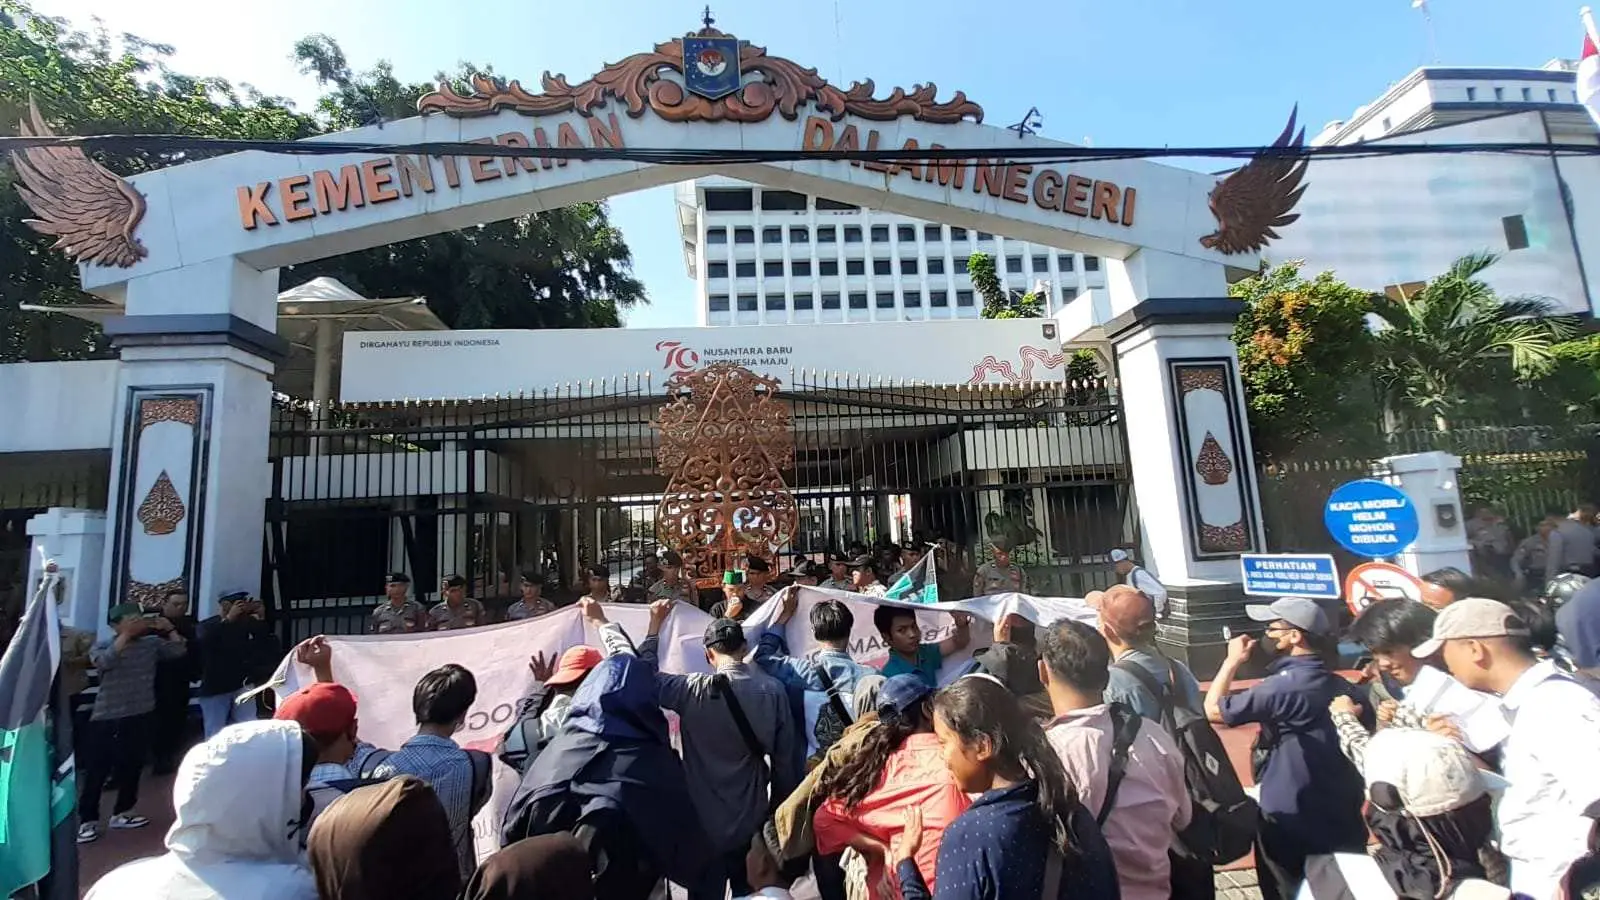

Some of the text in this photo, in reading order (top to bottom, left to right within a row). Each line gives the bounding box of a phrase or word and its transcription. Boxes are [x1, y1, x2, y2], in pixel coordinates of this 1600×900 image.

[237, 113, 1136, 229] KEMENTERIAN DALAM NEGERI
[360, 339, 500, 349] DIRGAHAYU REPUBLIK INDONESIA
[703, 346, 793, 357] NUSANTARA BARU
[760, 357, 789, 366] MAJU
[1329, 501, 1361, 511] KACA
[1352, 511, 1387, 521] HELM
[1348, 522, 1396, 533] MOHON
[1351, 534, 1398, 544] DIBUKA
[1255, 560, 1317, 571] PERHATIAN
